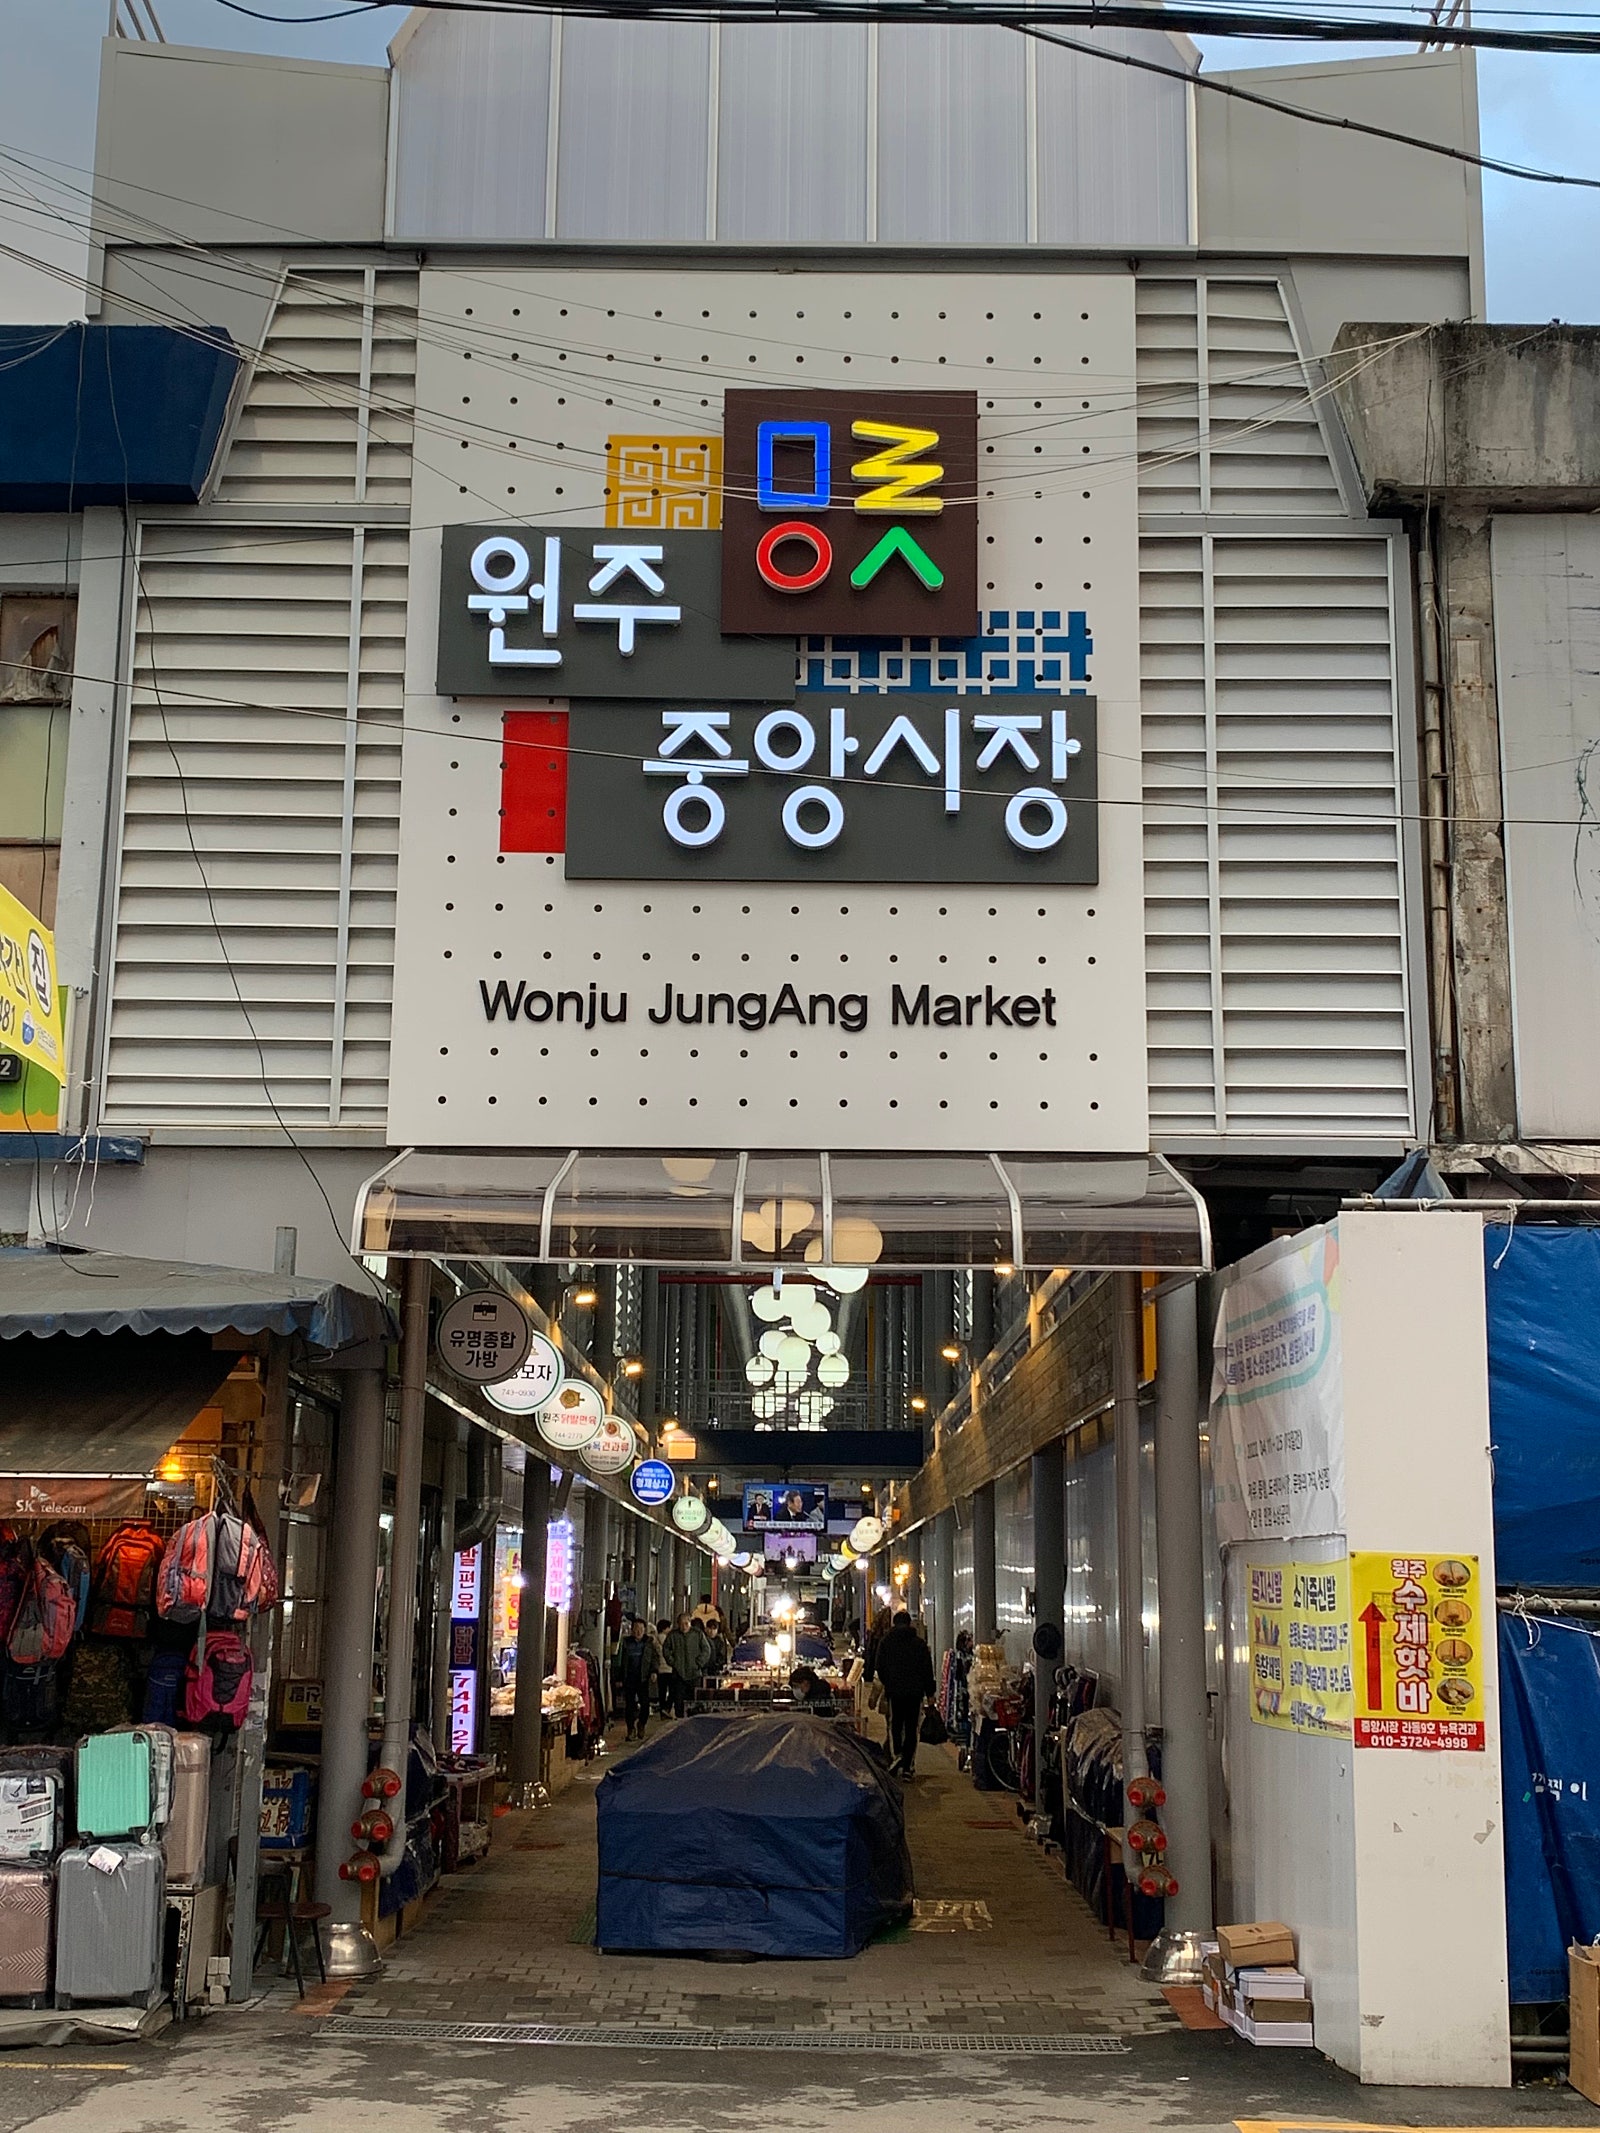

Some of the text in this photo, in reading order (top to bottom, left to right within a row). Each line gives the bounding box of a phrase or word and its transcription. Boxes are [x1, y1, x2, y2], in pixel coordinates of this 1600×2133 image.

[467, 535, 681, 667] 원주
[643, 707, 1082, 852] 중앙시장
[479, 979, 1058, 1031] Wonju JungAng Market
[450, 1330, 516, 1349] 유명종합
[465, 1350, 498, 1368] 가방
[510, 1363, 552, 1381] 모자
[16, 1500, 87, 1513] SK telecom
[1392, 1559, 1426, 1578] 원주
[1394, 1580, 1431, 1713] 수제핫바
[1361, 1720, 1399, 1733] 중앙시장
[1440, 1722, 1477, 1735] 뉴욕견과
[1371, 1735, 1468, 1748] 010-3724-4998
